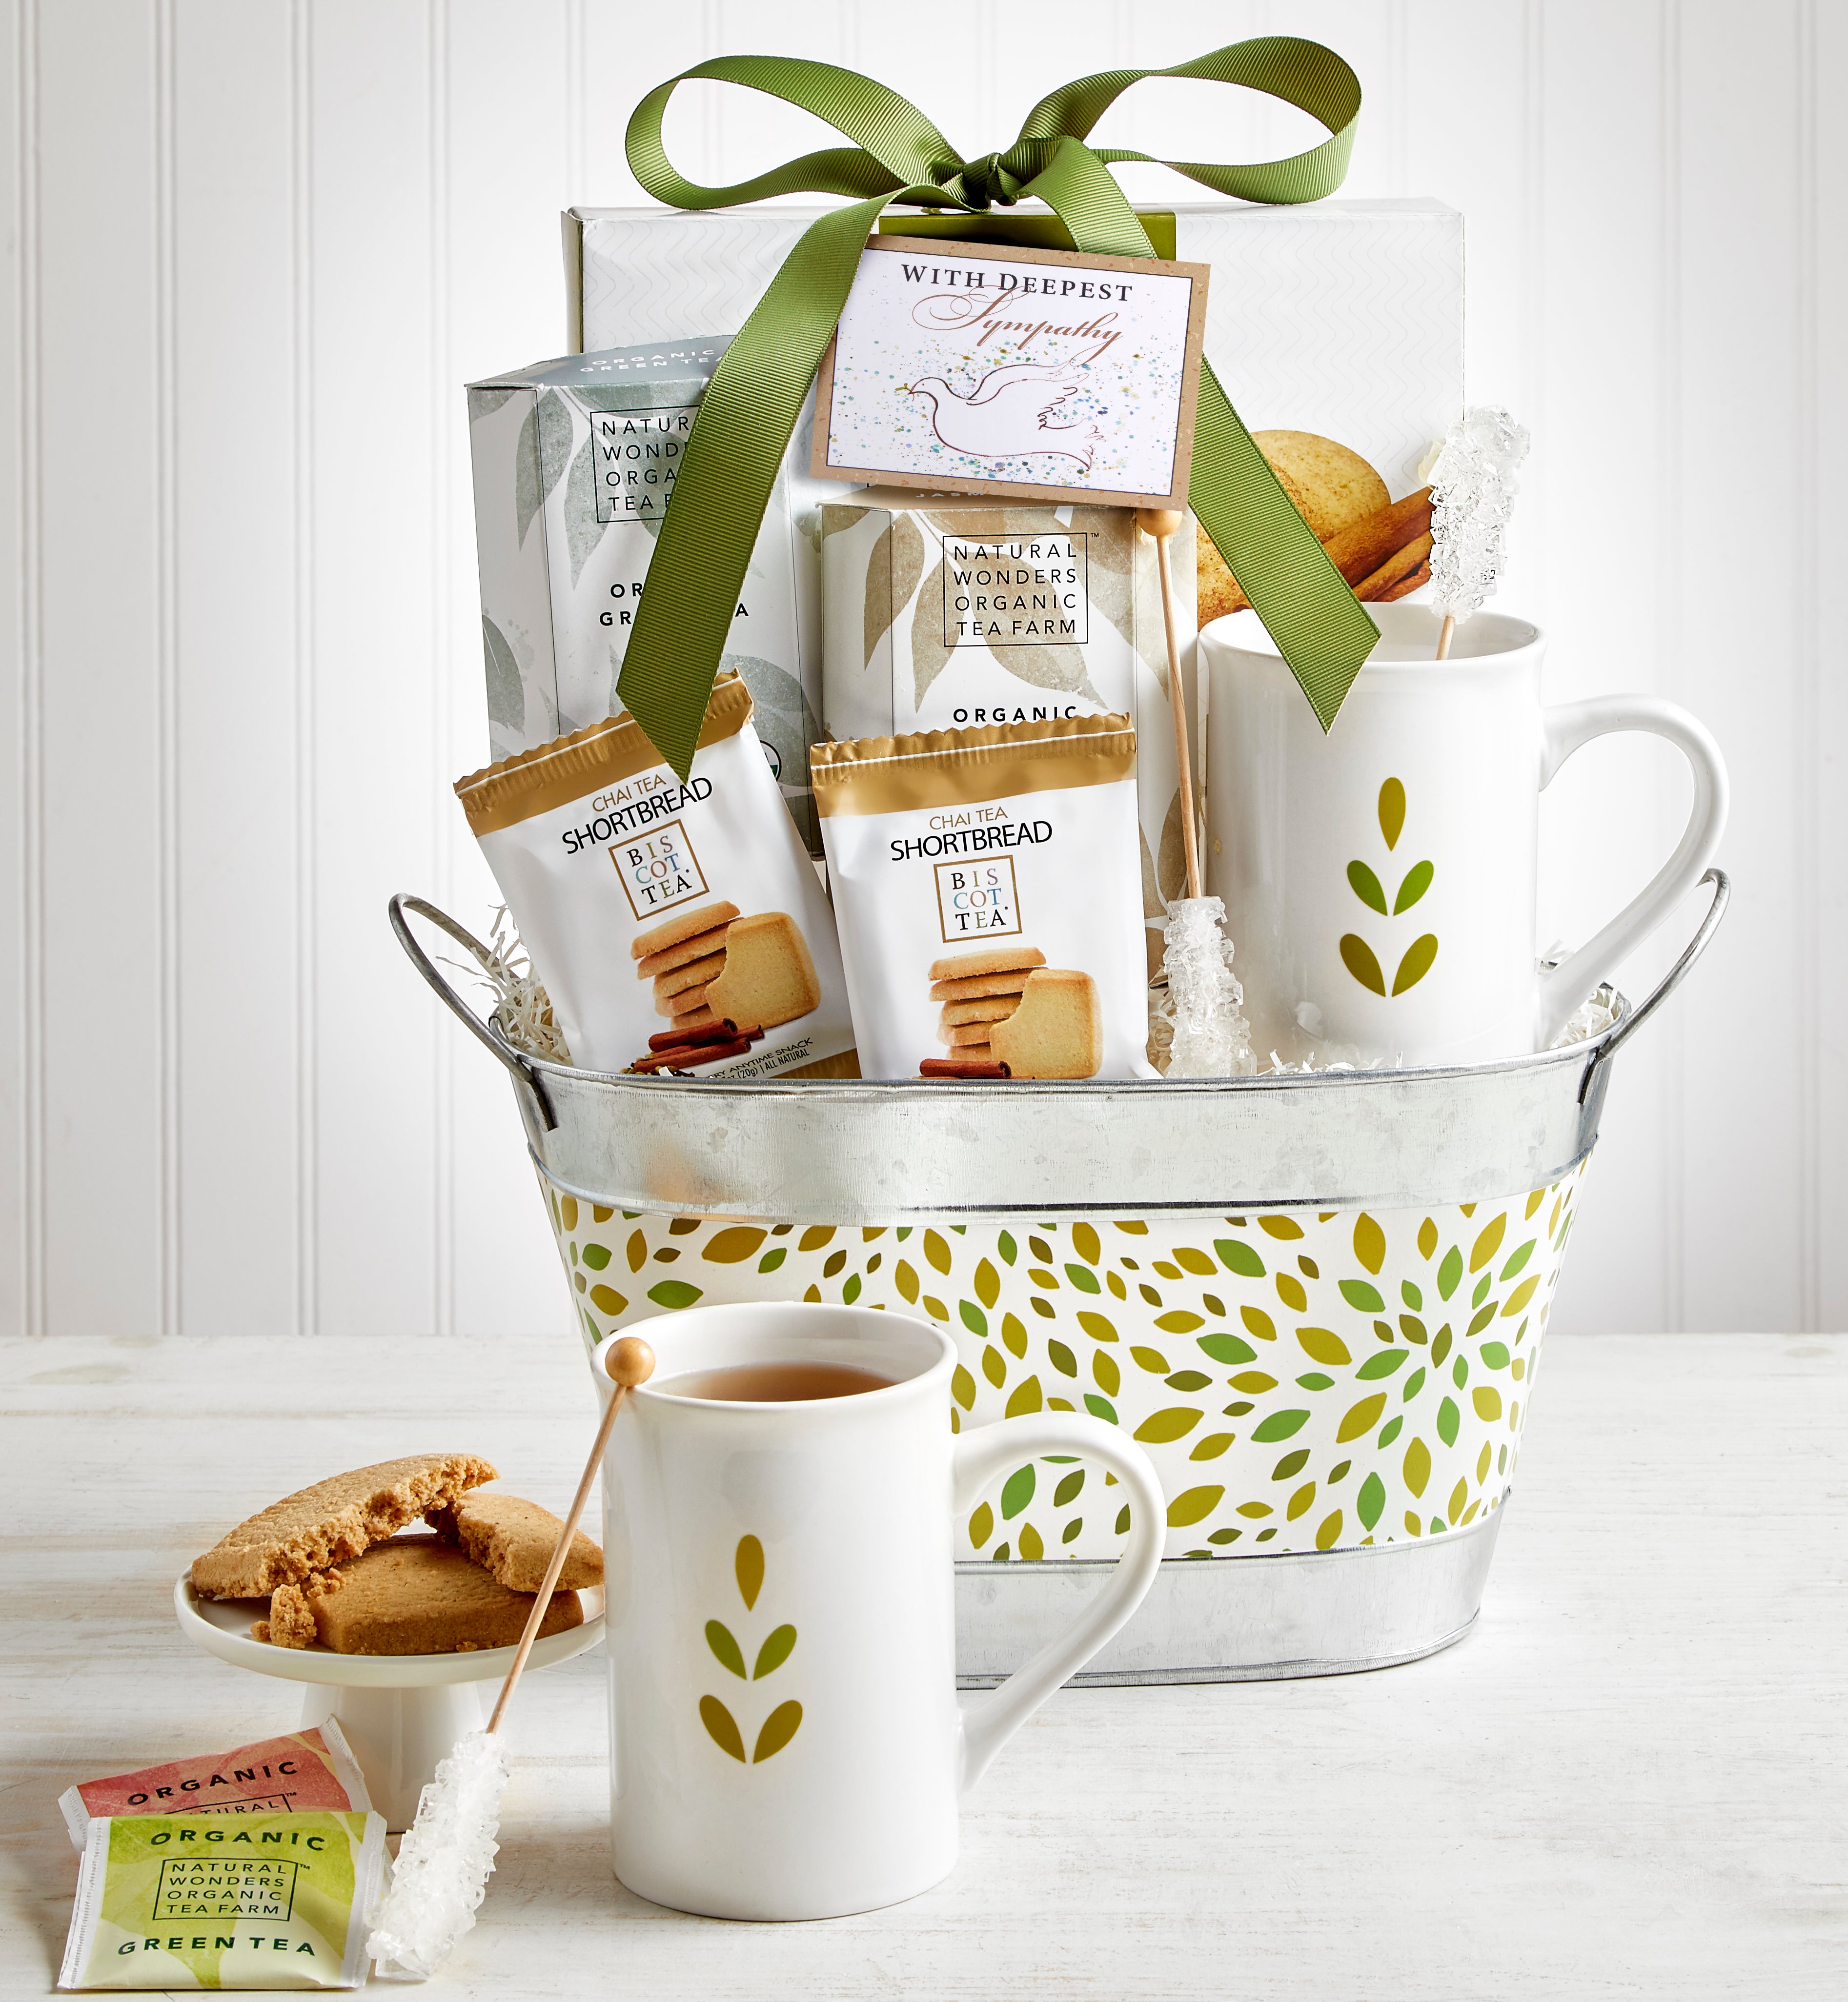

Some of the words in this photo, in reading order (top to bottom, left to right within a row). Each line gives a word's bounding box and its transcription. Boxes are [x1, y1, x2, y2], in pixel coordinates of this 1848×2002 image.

[901, 264, 985, 288] WITH
[998, 273, 1133, 301] DEEPEST
[912, 285, 1123, 366] Sympathy
[580, 361, 667, 372] GREEN
[592, 350, 715, 365] ORGANIC
[602, 416, 689, 436] NATUR
[603, 441, 688, 461] WOND
[606, 468, 676, 486] ORGA
[608, 495, 654, 511] TEA
[954, 544, 1076, 560] NATURAL
[954, 568, 1076, 586] WONDERS
[955, 594, 1076, 611] ORGANIC
[956, 622, 1001, 636] TEA
[1013, 619, 1075, 635] FARM
[953, 706, 1076, 723] ORGANIC
[592, 786, 632, 812] CHAI
[633, 774, 667, 794] TEA
[562, 777, 713, 854] SHORTBREAD
[929, 812, 971, 830] CHAI
[975, 806, 1008, 823] TEA
[626, 835, 673, 867] BIS
[890, 821, 1053, 861] SHORTBREAD
[635, 853, 680, 884] COT
[951, 868, 998, 890] BIS
[953, 888, 1001, 910] COT
[730, 1052, 773, 1073] ANYTIME
[775, 1037, 813, 1056] SNACK
[766, 1059, 778, 1071] ALL
[778, 1048, 810, 1066] NATURAL
[127, 1761, 298, 1806] ORGANIC
[150, 1829, 325, 1851] ORGANIC
[172, 1863, 286, 1874] NATURAL
[169, 1877, 284, 1887] WONDERS
[167, 1890, 282, 1901] ORGANIC
[167, 1904, 208, 1913] TEA
[218, 1905, 280, 1915] FARM
[118, 1937, 235, 1955] GREEN
[249, 1937, 316, 1956] TEA
